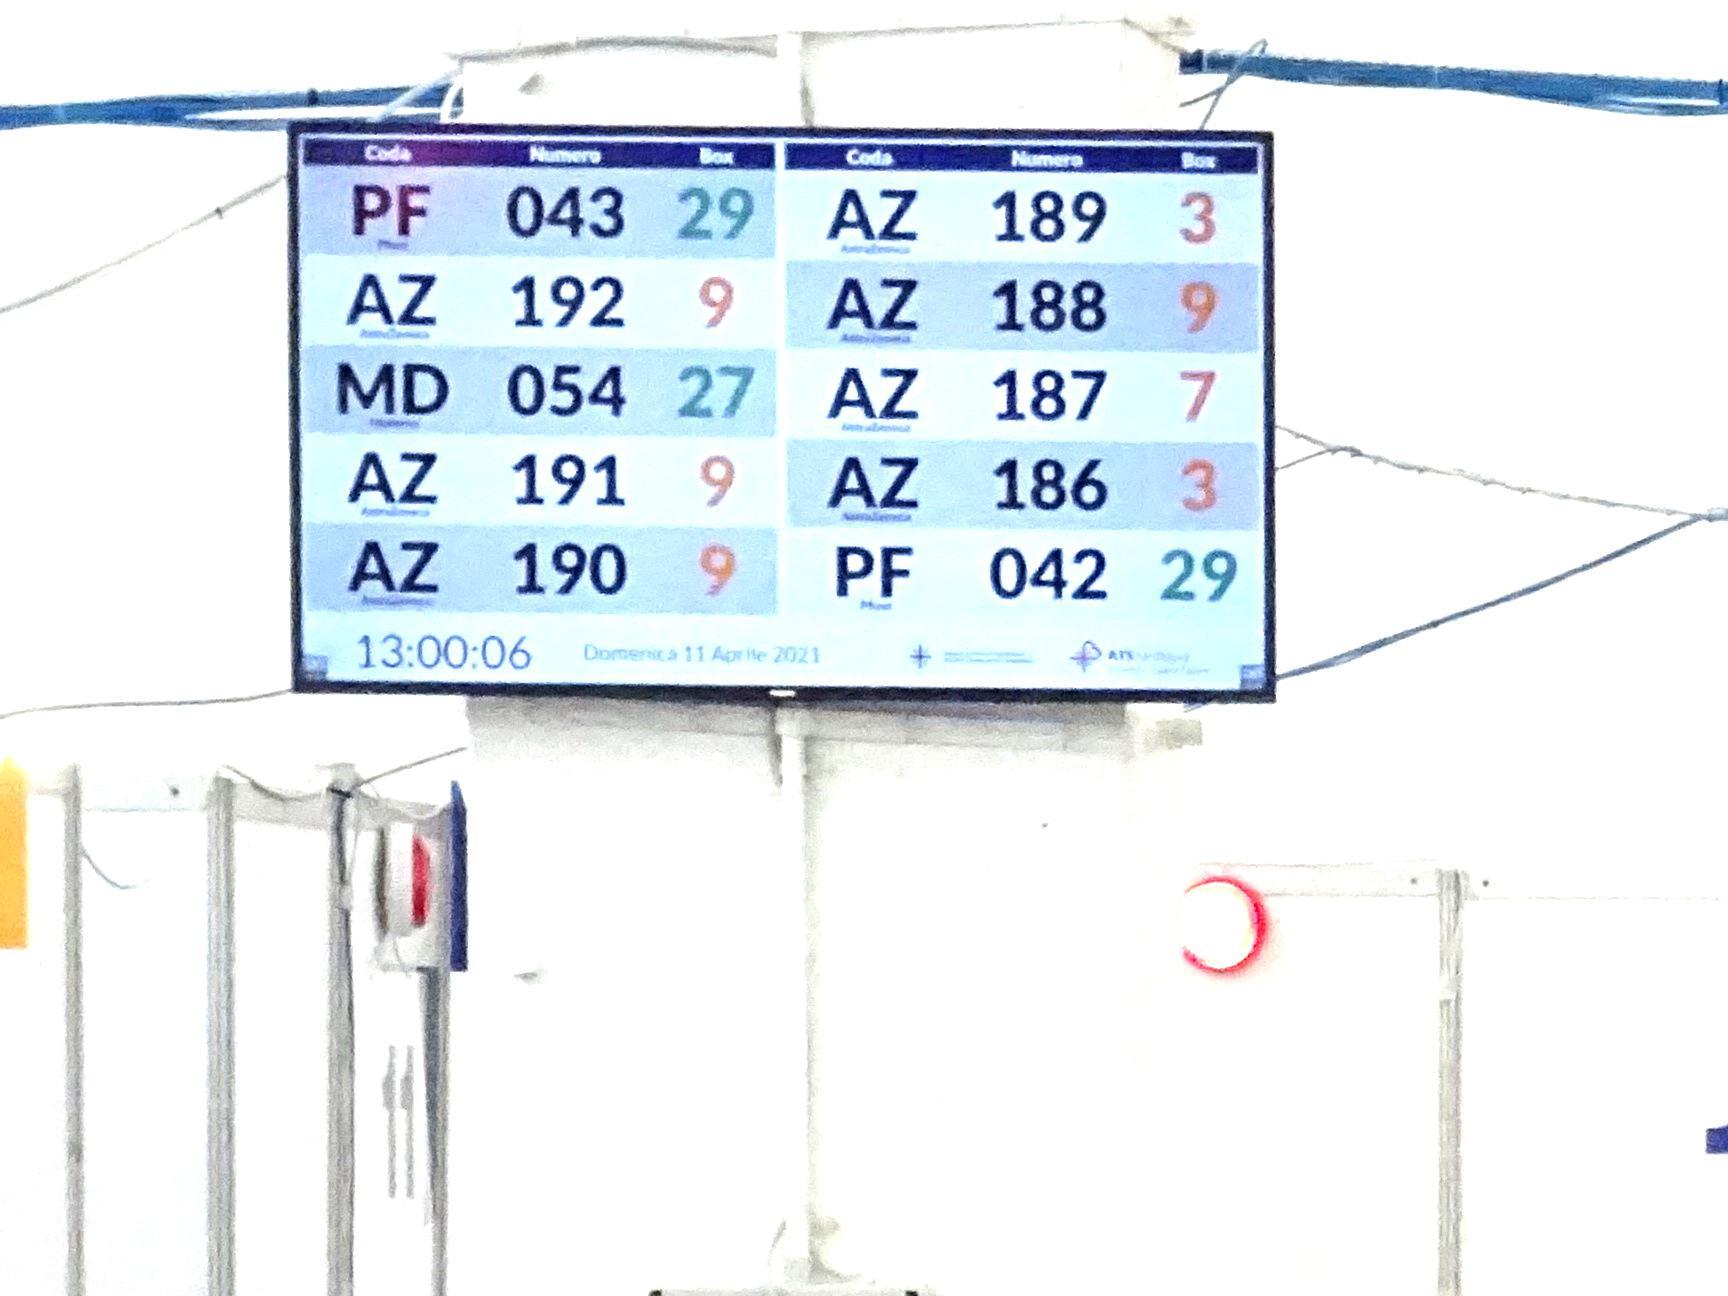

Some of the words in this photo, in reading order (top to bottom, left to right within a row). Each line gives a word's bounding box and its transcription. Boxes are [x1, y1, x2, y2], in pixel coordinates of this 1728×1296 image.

[1012, 150, 1084, 168] Numero
[1183, 152, 1217, 170] Box
[355, 186, 431, 236] PF
[508, 187, 625, 239] 043
[680, 188, 755, 240] 29
[829, 190, 918, 241] AZ
[995, 192, 1107, 243] 189
[1182, 193, 1216, 244] 3
[348, 275, 437, 326] AZ
[514, 277, 625, 328] 192
[700, 278, 734, 329] 9
[829, 279, 919, 331] AZ
[995, 281, 1107, 333] 188
[1182, 283, 1218, 334] 9
[339, 364, 449, 416] MD
[509, 366, 626, 417] 054
[679, 367, 755, 419] 27
[830, 369, 919, 419] AZ
[995, 371, 1107, 422] 187
[1182, 372, 1216, 422] 7
[350, 454, 438, 504] AZ
[514, 455, 625, 506] 191
[702, 457, 735, 507] 9
[830, 458, 919, 509] AZ
[996, 460, 1108, 512] 186
[1184, 461, 1217, 512] 3
[350, 543, 439, 593] AZ
[516, 544, 627, 596] 190
[702, 547, 736, 596] 9
[838, 548, 913, 598] PF
[992, 549, 1108, 600] 042
[1162, 551, 1238, 602] 29
[360, 635, 532, 670] 13:00:06
[686, 645, 704, 664] 11
[774, 646, 821, 665] 2021
